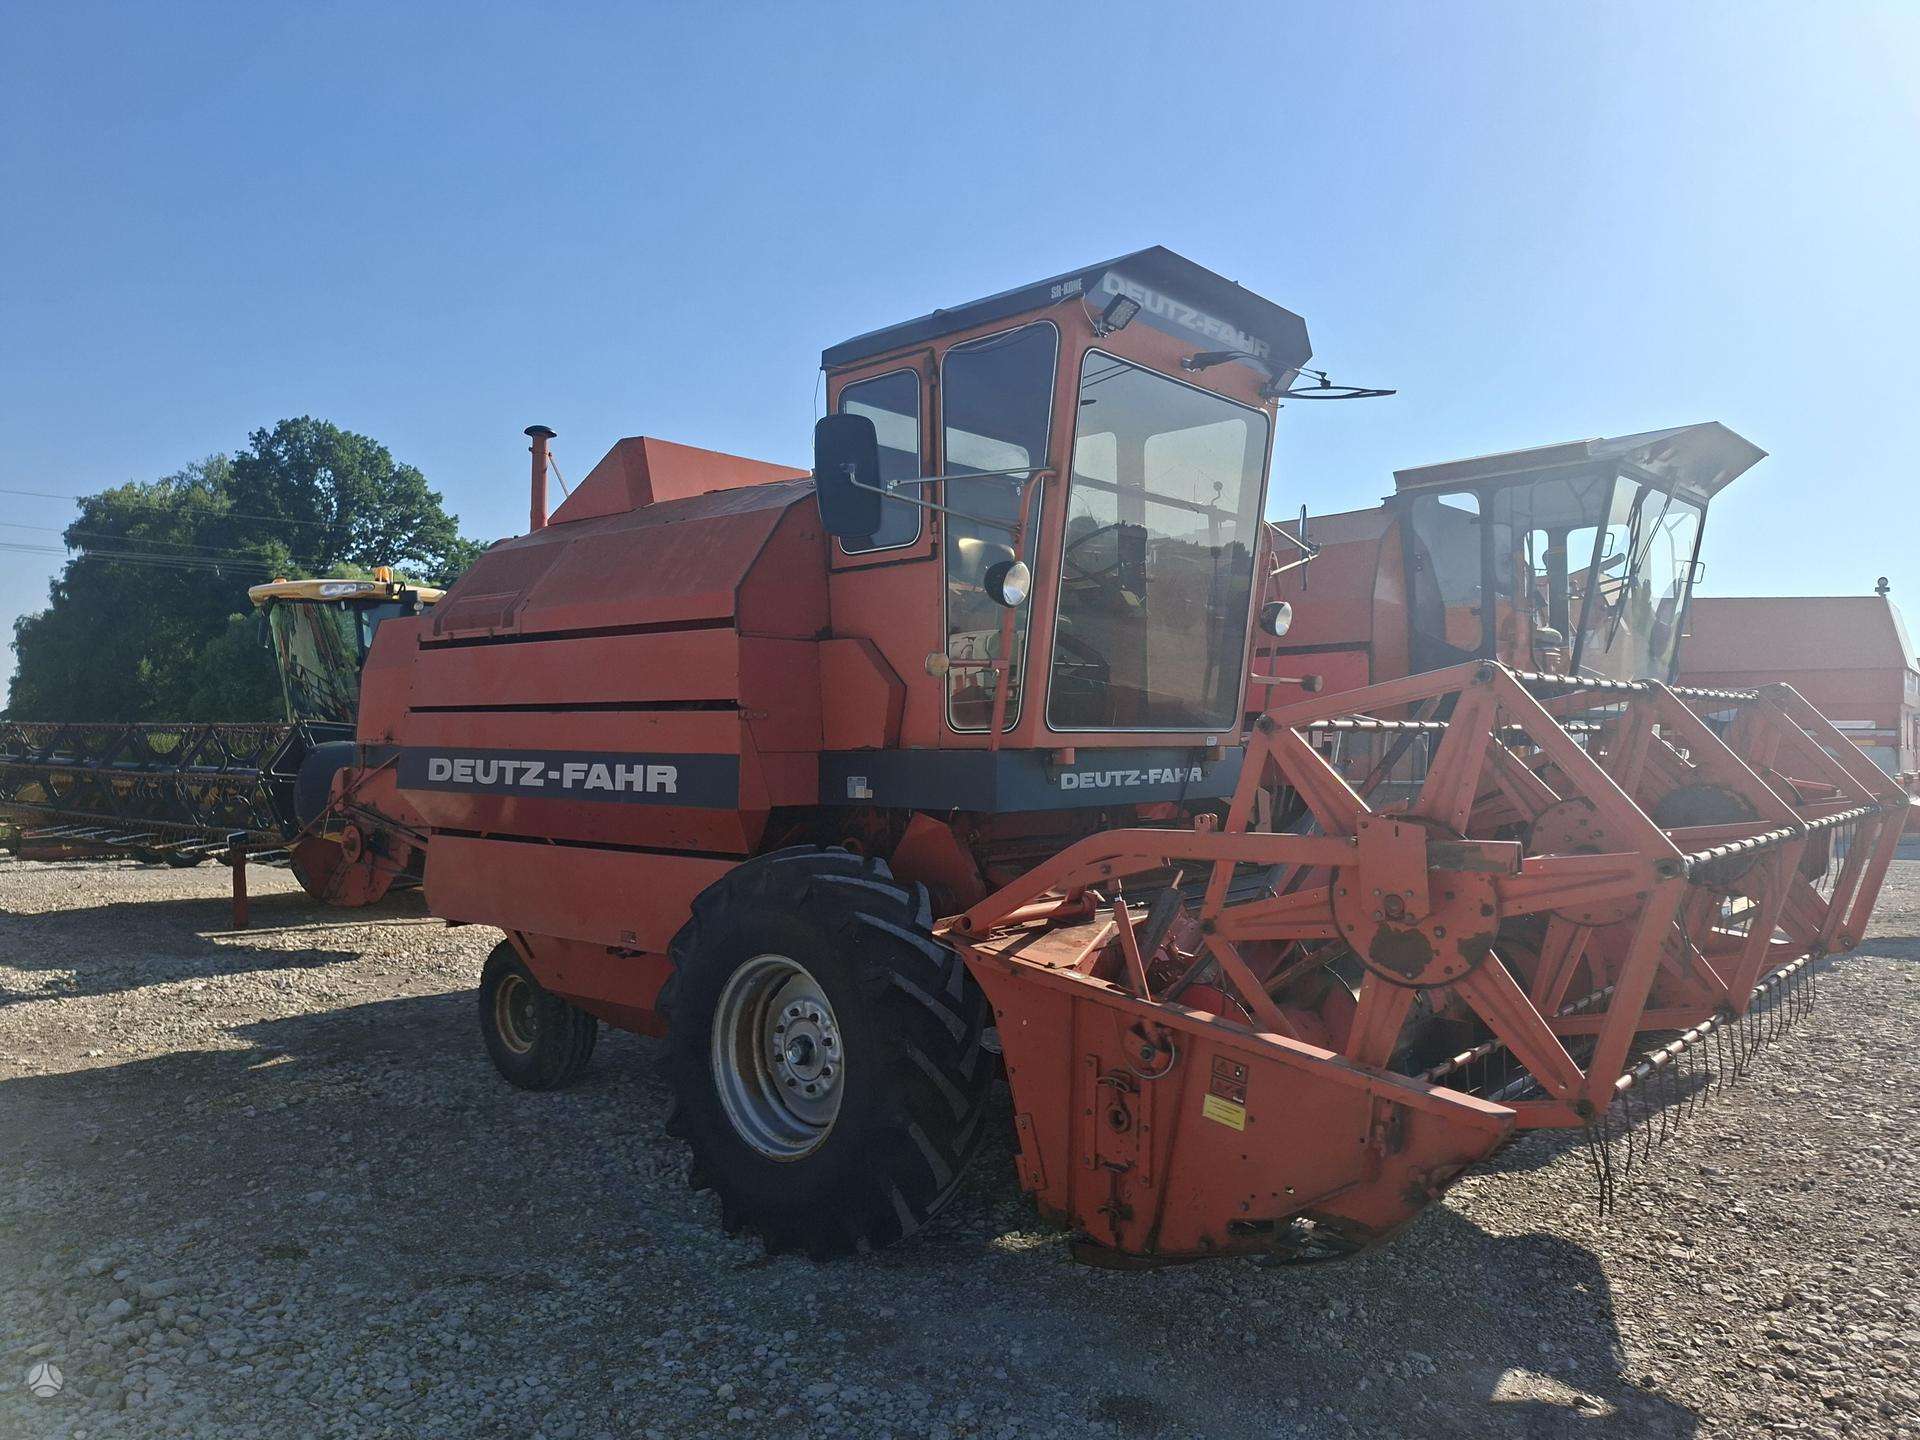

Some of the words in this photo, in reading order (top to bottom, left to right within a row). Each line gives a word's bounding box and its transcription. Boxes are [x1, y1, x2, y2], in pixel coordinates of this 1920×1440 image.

[1102, 271, 1271, 359] DEUTZ-FAHR
[427, 757, 678, 793] DEUTZ-FAHR
[1060, 767, 1203, 790] DEUTZ-FAHR
